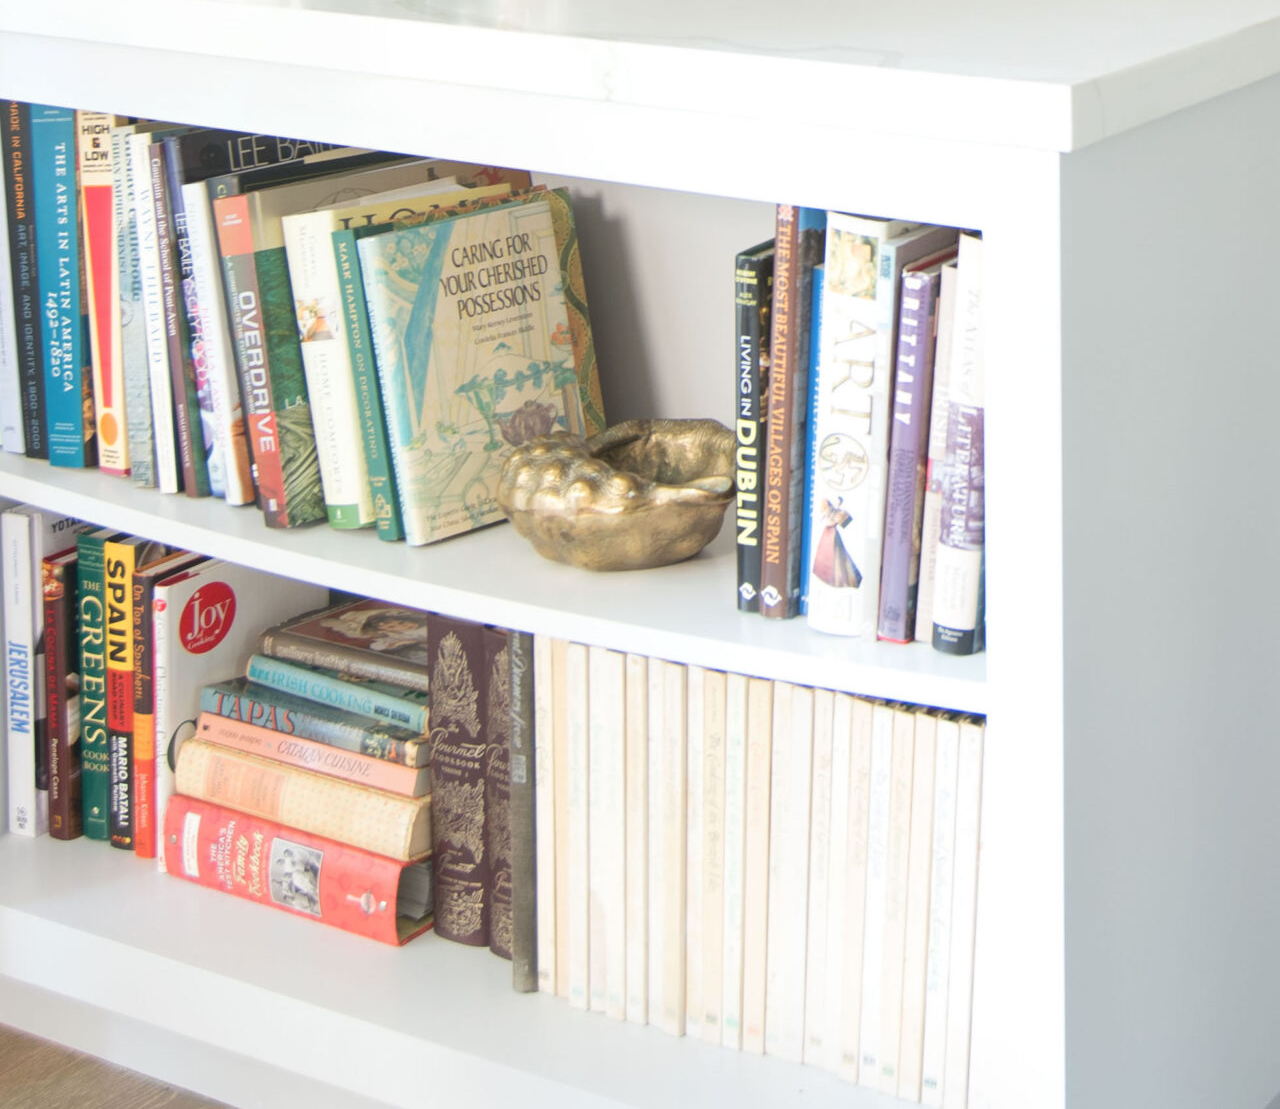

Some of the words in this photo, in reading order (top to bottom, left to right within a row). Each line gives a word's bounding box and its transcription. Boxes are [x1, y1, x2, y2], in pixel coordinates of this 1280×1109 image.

[9, 100, 20, 131] MADE
[82, 125, 110, 135] HIGH
[11, 136, 21, 148] IN
[54, 142, 67, 177] THE
[85, 151, 109, 161] LOW
[227, 134, 269, 172] LEE
[12, 151, 26, 220] CALIFORNIA
[151, 158, 161, 198] Gauguin
[56, 183, 68, 225] ARTS
[156, 201, 165, 215] and
[58, 231, 70, 250] IN
[157, 217, 167, 232] the
[175, 213, 187, 235] LEE
[777, 225, 791, 254] THE
[160, 235, 171, 267] School
[338, 242, 351, 280] MARK
[451, 238, 504, 268] CARING
[507, 233, 533, 256] FOR
[59, 257, 72, 309] LATIN
[440, 271, 477, 298] YOUR
[477, 254, 548, 289] CHERISHED
[776, 256, 790, 310] MOST
[21, 295, 32, 319] AND
[164, 283, 177, 336] Pont-Aven
[346, 283, 362, 349] HAMPTON
[457, 282, 542, 320] POSSESSIONS
[60, 316, 74, 392] AMERICA
[355, 353, 365, 372] ON
[740, 335, 752, 394] LIVING
[773, 313, 789, 404] BEAUTIFUL
[895, 277, 922, 425] BRITTANY
[238, 291, 276, 453] OVERDRIVE
[830, 319, 877, 436] ART
[359, 376, 378, 460] DECORATING
[740, 397, 752, 416] IN
[767, 407, 785, 487] VILLAGES
[736, 418, 757, 546] DUBLIN
[950, 406, 978, 546] LITERATURE
[767, 490, 781, 509] OF
[766, 517, 781, 564] SPAIN
[83, 580, 102, 591] THE
[133, 585, 144, 600] On
[107, 557, 127, 664] SPAIN
[133, 605, 145, 624] Top
[134, 629, 145, 640] of
[8, 641, 30, 734] JERUSALEM
[81, 595, 107, 745] GREENS
[271, 669, 308, 694] IRISH
[310, 683, 372, 715] COOKING
[214, 691, 298, 734] TAPAS
[51, 738, 59, 773] Penelope
[83, 750, 109, 760] COOK
[118, 737, 128, 781] MARIO
[277, 739, 323, 763] CATALAN
[325, 752, 371, 778] CUISINE
[430, 727, 486, 759] Gourmet
[434, 752, 481, 769] COOKBOOK
[83, 761, 109, 772] BOOK
[52, 776, 60, 799] Casas
[118, 783, 129, 827] BATALI
[209, 842, 218, 862] THE
[217, 827, 227, 882] AMERICA'S
[225, 820, 236, 865] KITCHEN
[233, 835, 250, 885] Family
[248, 830, 265, 898] Cookbook
